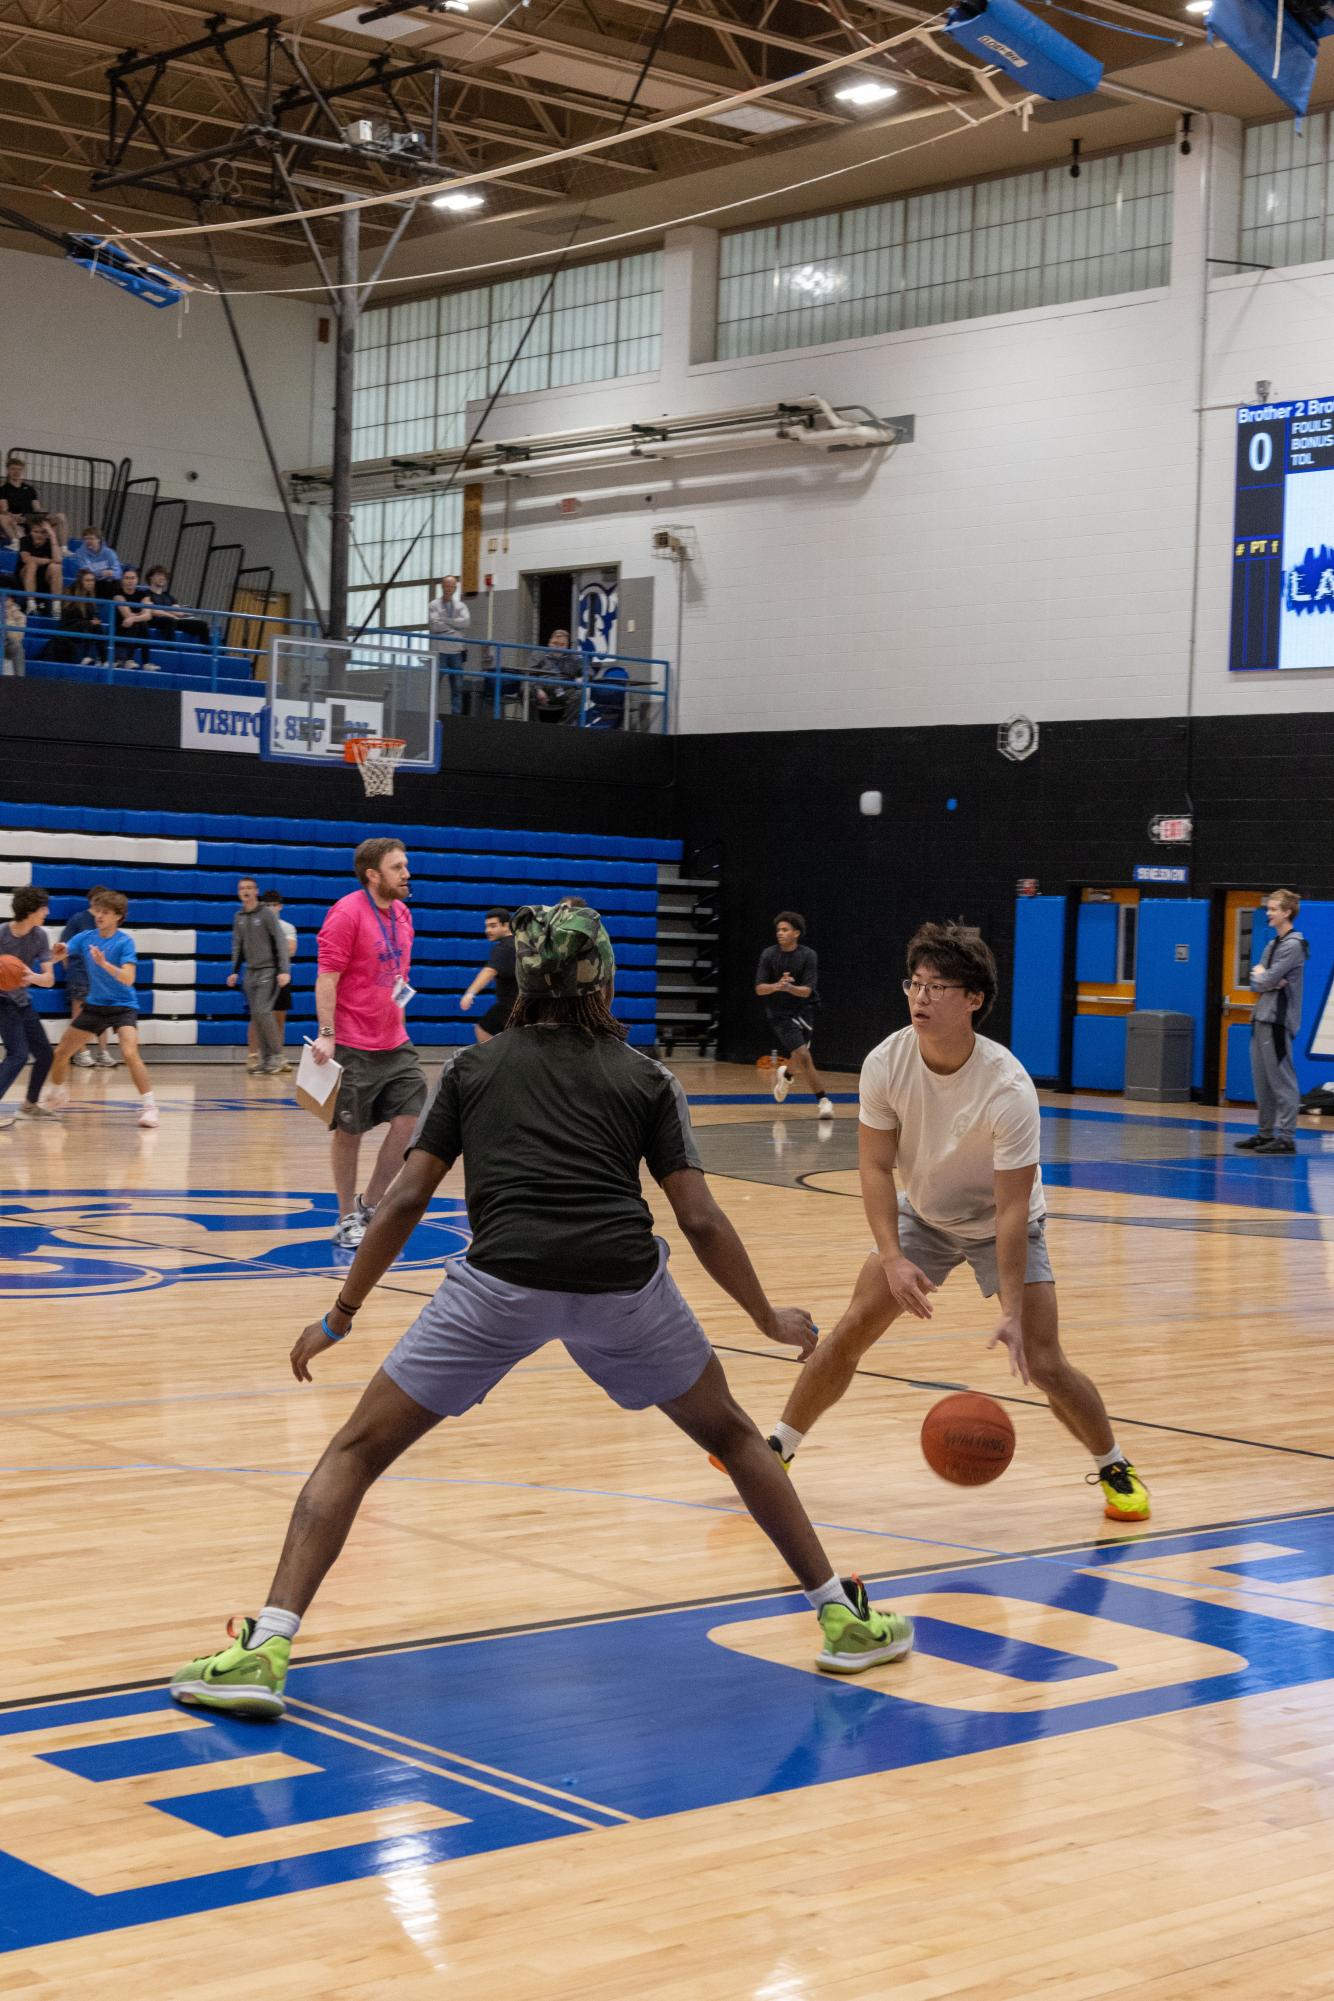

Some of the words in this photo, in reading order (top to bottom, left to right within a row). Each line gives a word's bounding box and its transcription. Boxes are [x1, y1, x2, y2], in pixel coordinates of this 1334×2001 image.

[1238, 405, 1293, 424] Brother
[1294, 402, 1306, 417] 2
[1307, 399, 1334, 416] Bro
[1291, 418, 1333, 435] FOULS
[1291, 434, 1334, 451] BONUS
[1248, 432, 1273, 472] 0
[1290, 452, 1316, 466] TOL
[1249, 540, 1268, 554] PT
